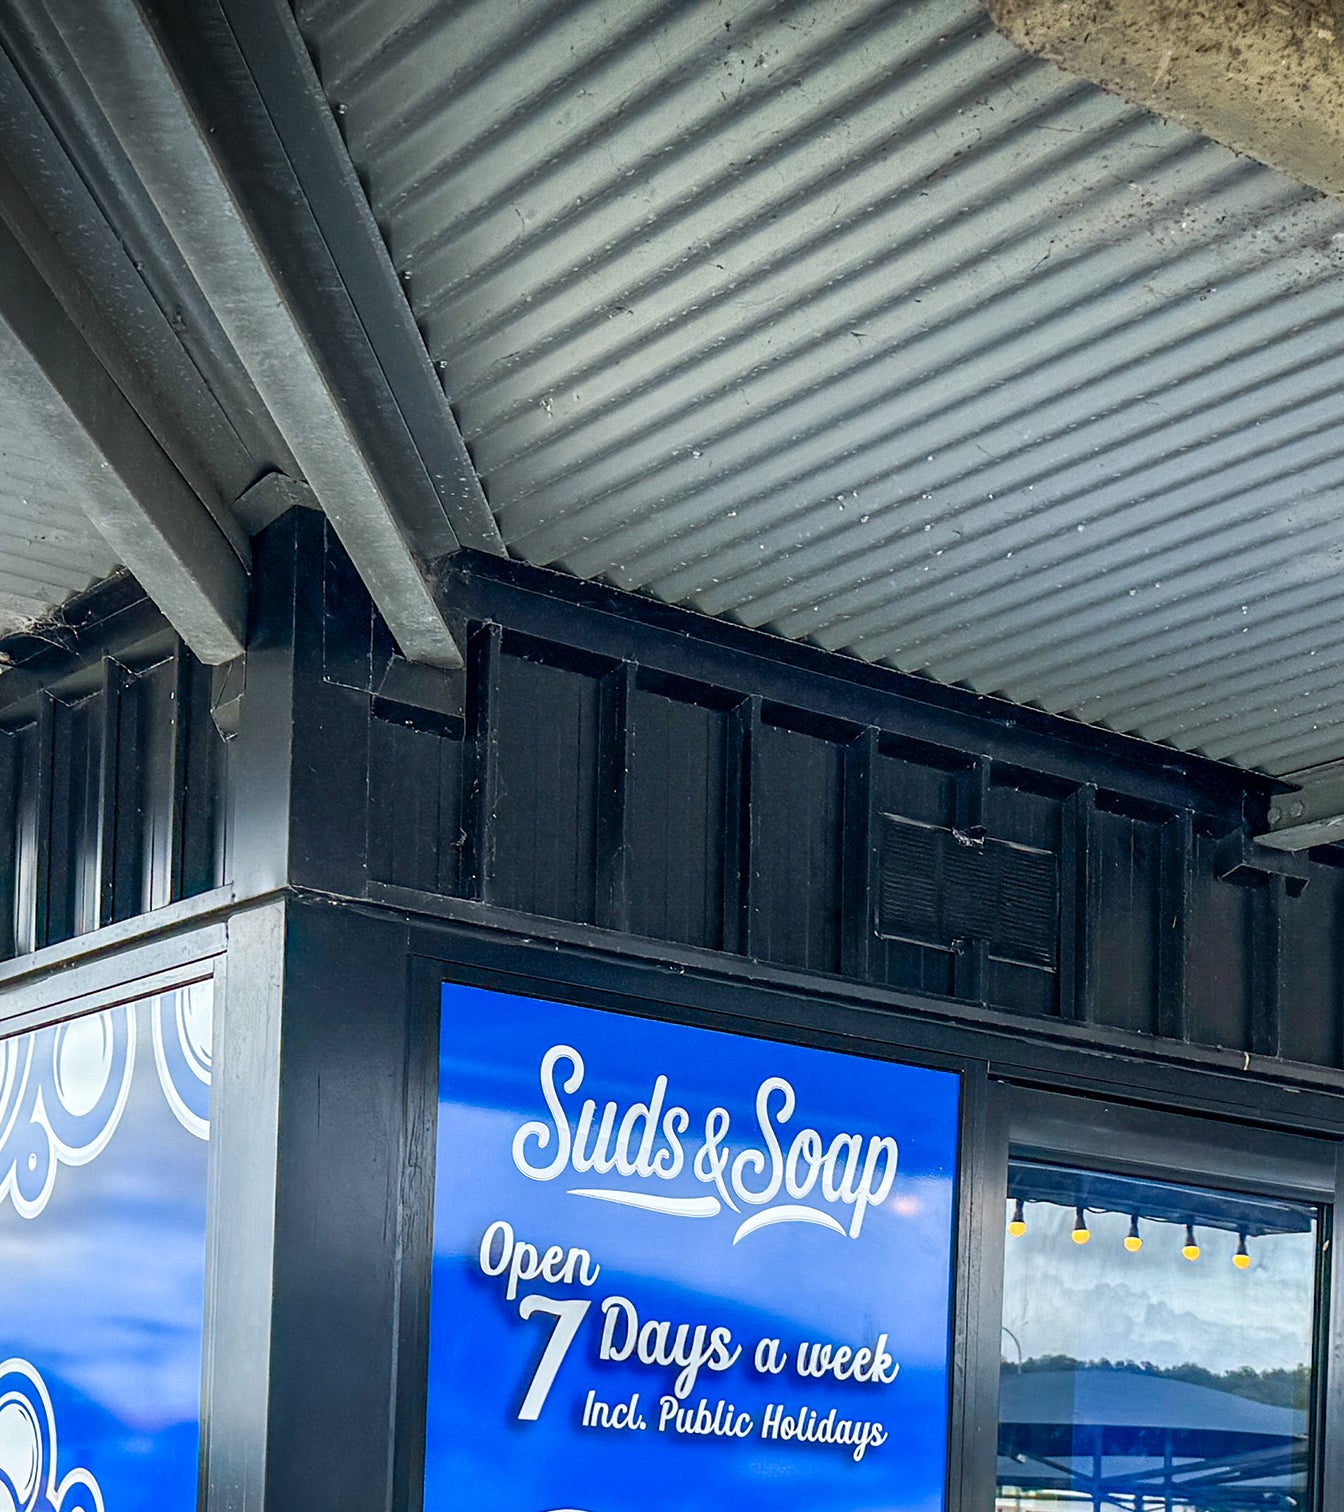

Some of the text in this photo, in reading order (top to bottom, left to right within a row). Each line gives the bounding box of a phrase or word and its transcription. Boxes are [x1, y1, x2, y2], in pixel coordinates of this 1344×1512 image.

[512, 1044, 898, 1238] Suds & Soap
[479, 1220, 600, 1300] Open
[517, 1294, 899, 1421] 7 Days a week
[582, 1390, 888, 1462] Incl. Public Holidays
